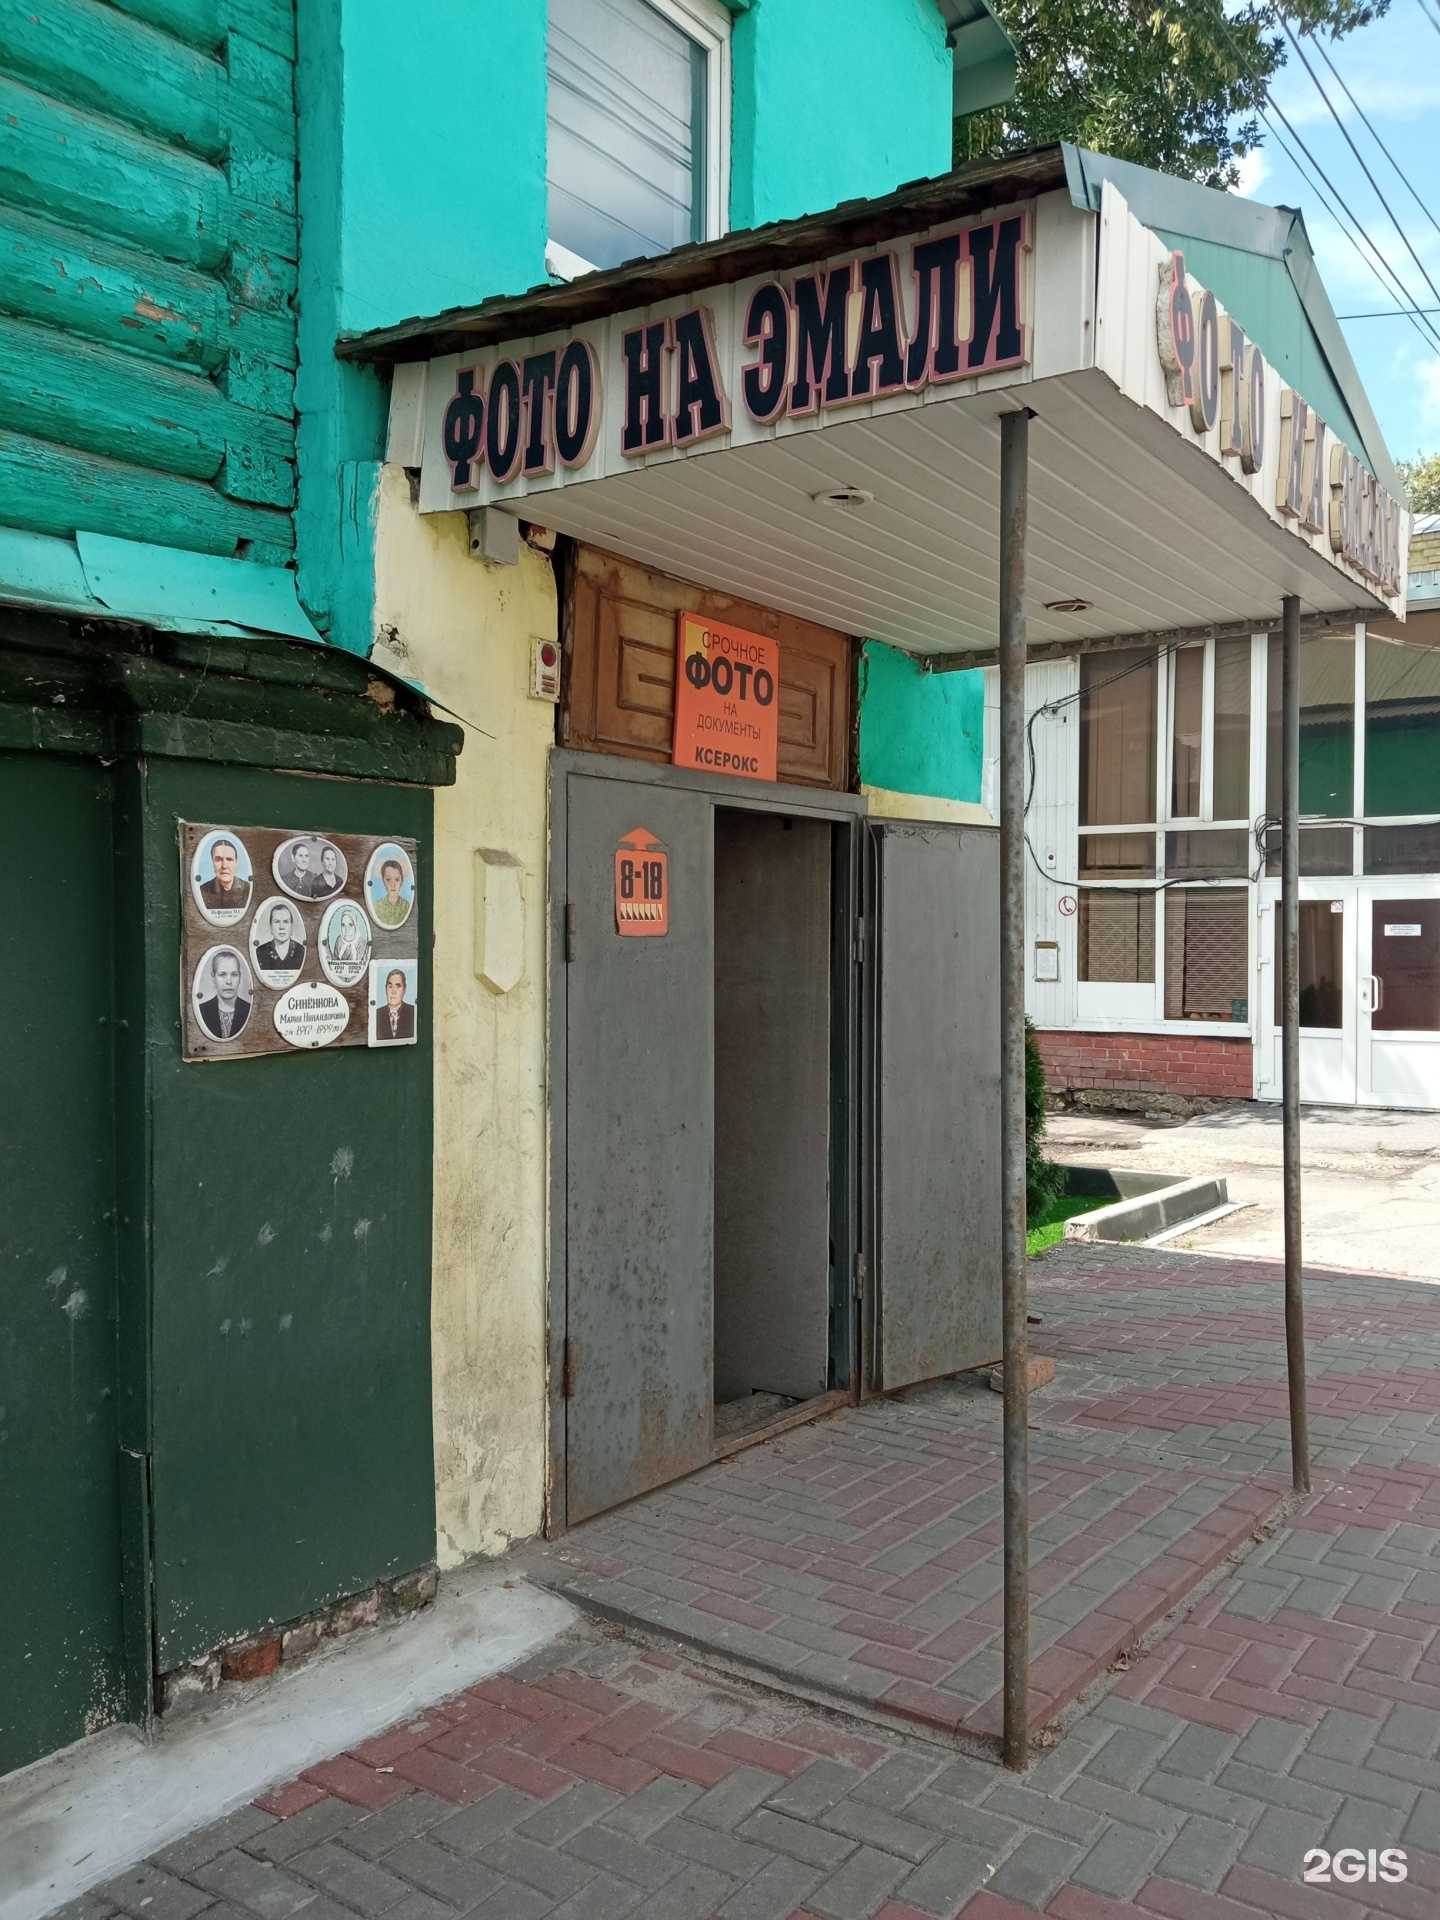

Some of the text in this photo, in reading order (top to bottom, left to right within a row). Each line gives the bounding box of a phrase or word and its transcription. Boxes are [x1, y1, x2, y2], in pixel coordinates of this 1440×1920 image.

[442, 210, 1033, 494] ФОТО НА ЭМАЛИ
[1157, 250, 1265, 475] ФОТО
[1276, 388, 1326, 535] НА
[702, 631, 767, 665] СРОЧНОЕ
[685, 651, 774, 706] ФОТО
[696, 714, 761, 741] ДОКУМЕНТЫ
[723, 703, 738, 717] НА
[695, 746, 759, 773] КСЕРОКС
[621, 860, 663, 899] 8-18
